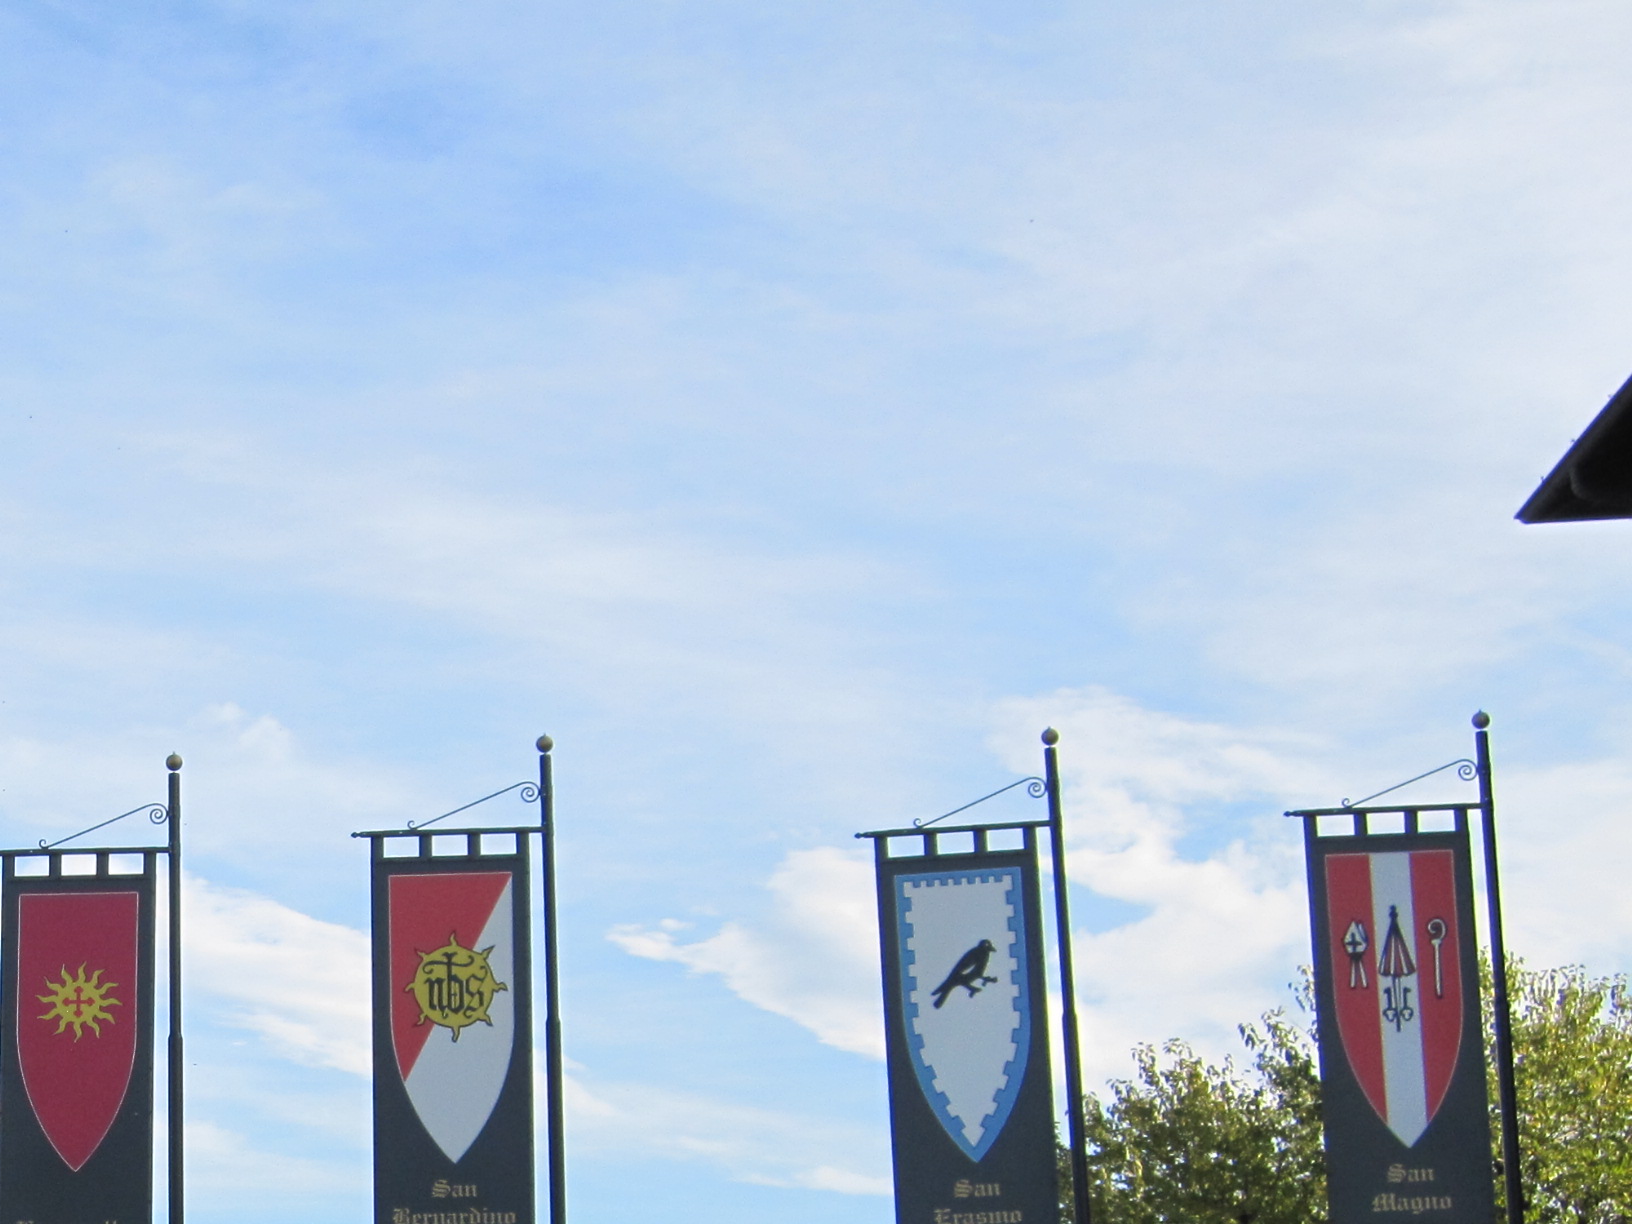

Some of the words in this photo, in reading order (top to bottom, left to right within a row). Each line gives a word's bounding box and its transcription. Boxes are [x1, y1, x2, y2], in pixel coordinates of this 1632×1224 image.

[1387, 1163, 1434, 1182] San
[431, 1179, 478, 1198] San
[953, 1179, 1000, 1198] San
[1371, 1193, 1452, 1214] Magno
